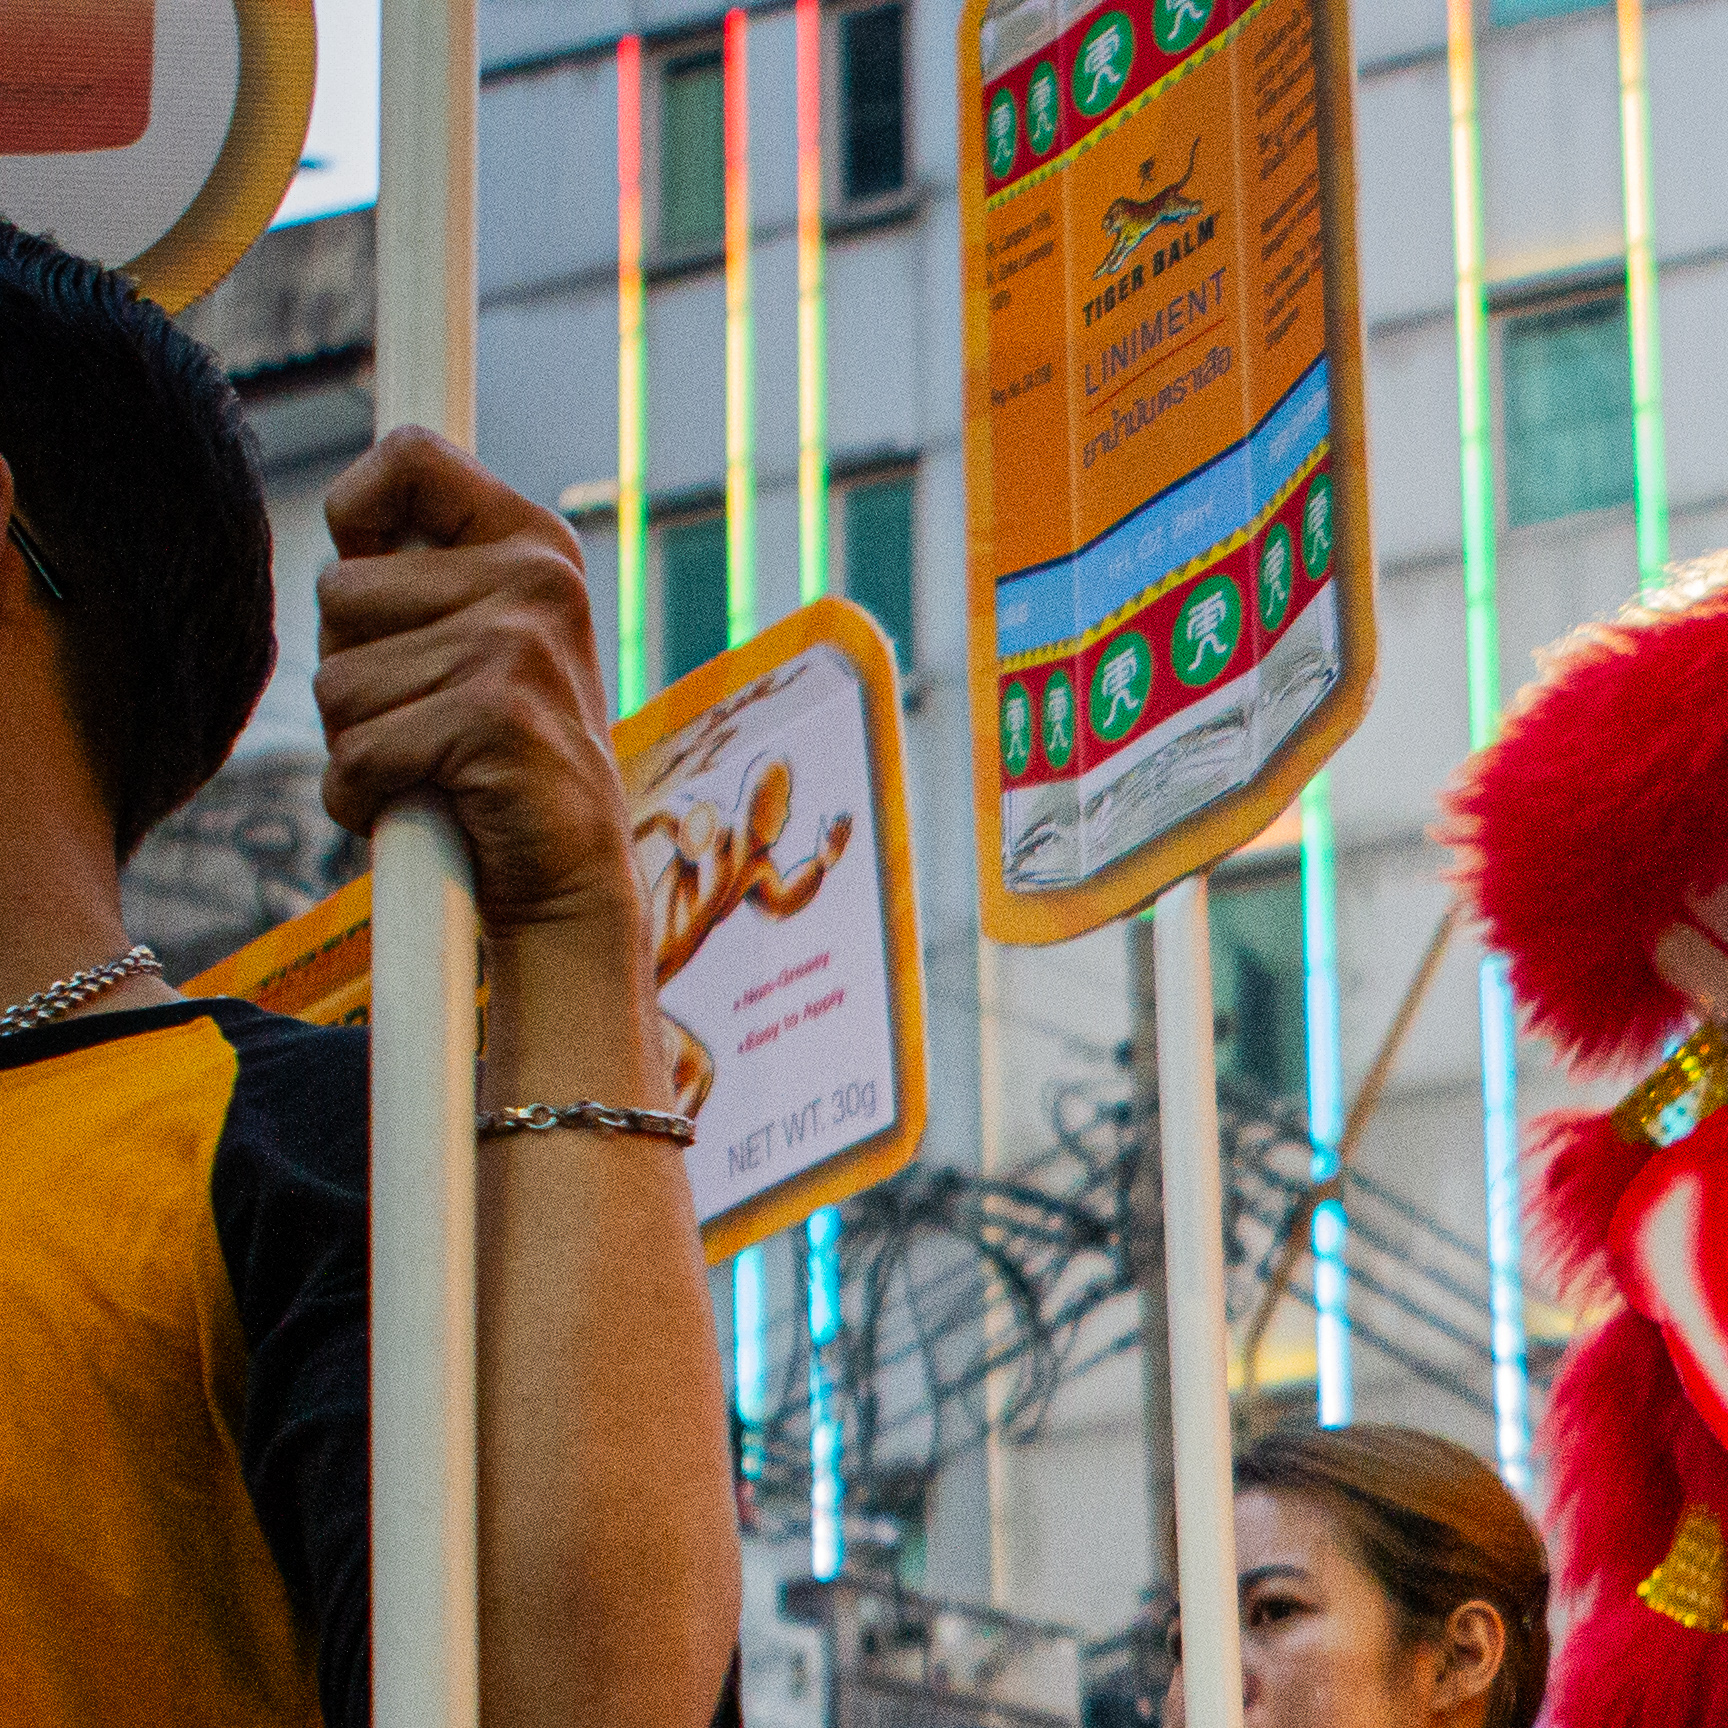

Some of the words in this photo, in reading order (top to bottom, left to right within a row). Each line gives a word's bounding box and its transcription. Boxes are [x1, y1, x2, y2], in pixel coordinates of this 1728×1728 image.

[1081, 264, 1145, 327] TIGER
[1151, 215, 1216, 278] BALM
[1083, 266, 1227, 397] LINIMENT
[727, 1126, 775, 1178] NET
[784, 1100, 821, 1151] WT.
[830, 1078, 878, 1129] 30g
